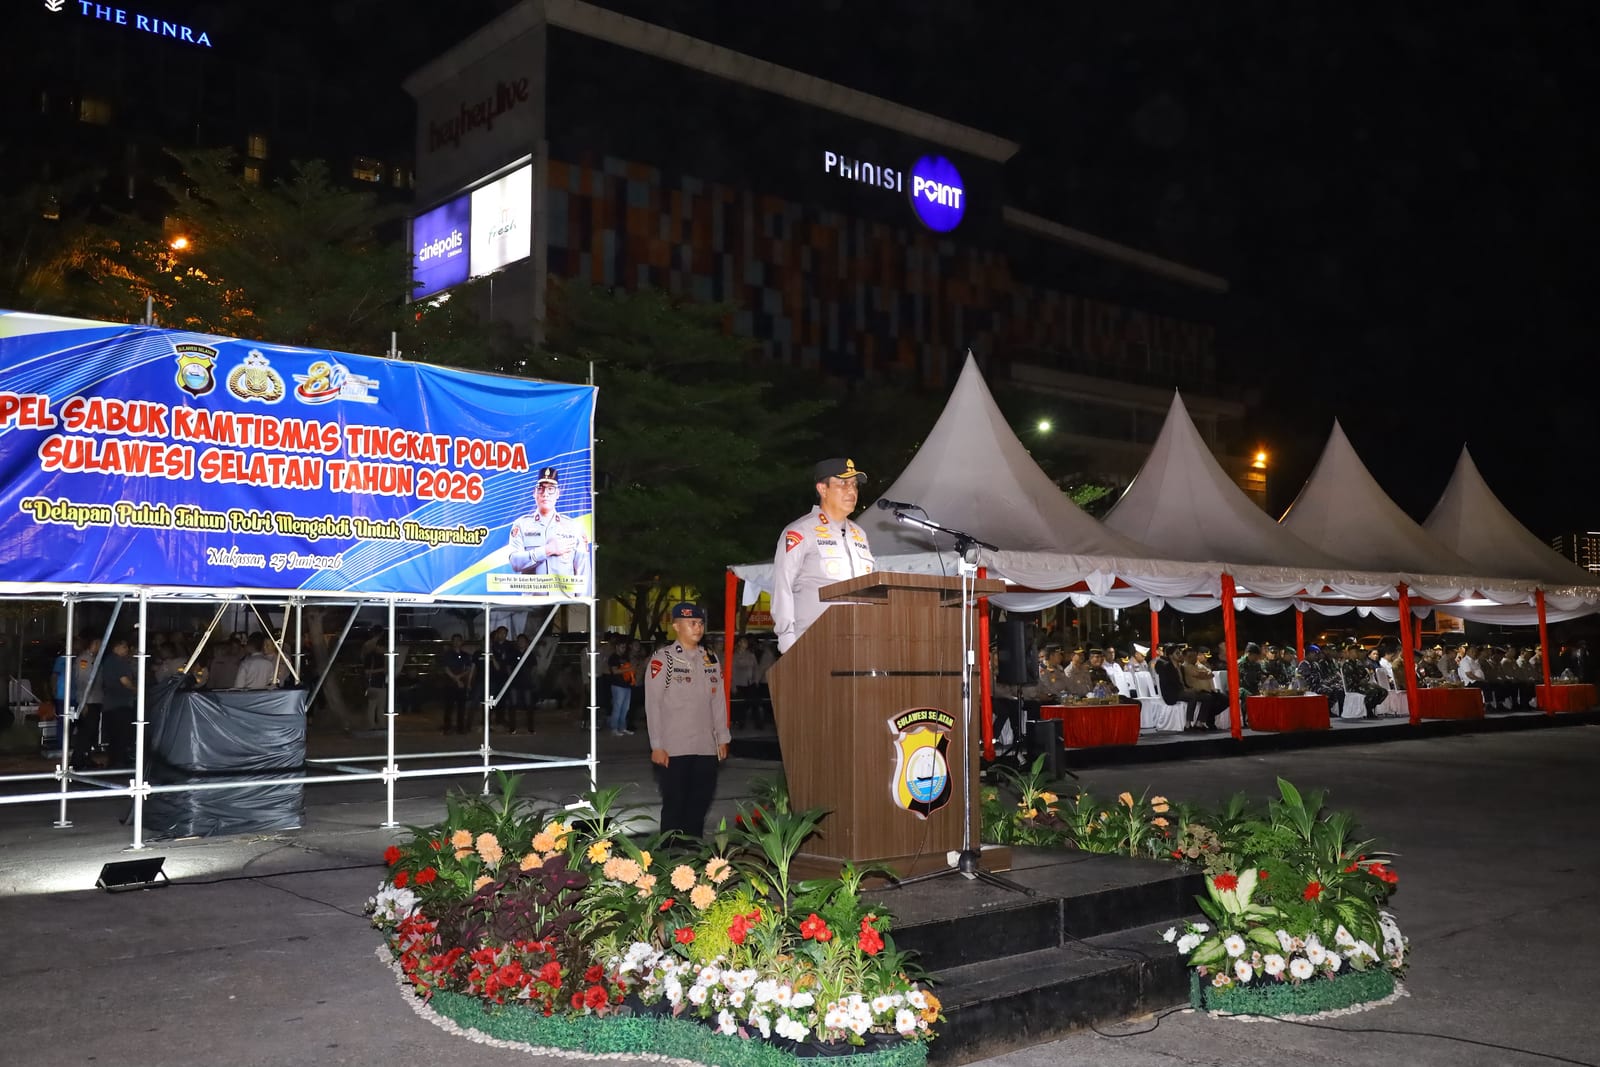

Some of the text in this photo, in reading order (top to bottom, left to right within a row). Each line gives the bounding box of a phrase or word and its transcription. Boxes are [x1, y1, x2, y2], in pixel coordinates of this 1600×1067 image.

[78, 0, 212, 47] THE RINRA
[824, 150, 962, 209] PHINISI POINT
[419, 228, 463, 261] cinépolis
[62, 399, 167, 434] SABUK
[174, 408, 339, 451] KAMTIBMAS
[347, 427, 450, 464] TINGKAT
[456, 439, 528, 471] POLDA
[41, 437, 483, 500] SULAWESI SELATAN TAHUN 2026
[116, 503, 171, 527] Puluh
[175, 507, 225, 530] Tahun
[230, 511, 273, 532] Polri
[276, 514, 351, 539] Mengabdi
[354, 518, 401, 538] Untuk
[207, 546, 343, 571] Makassar, 25 Juni 2026
[896, 710, 955, 729] SULAWESI SEATAN
